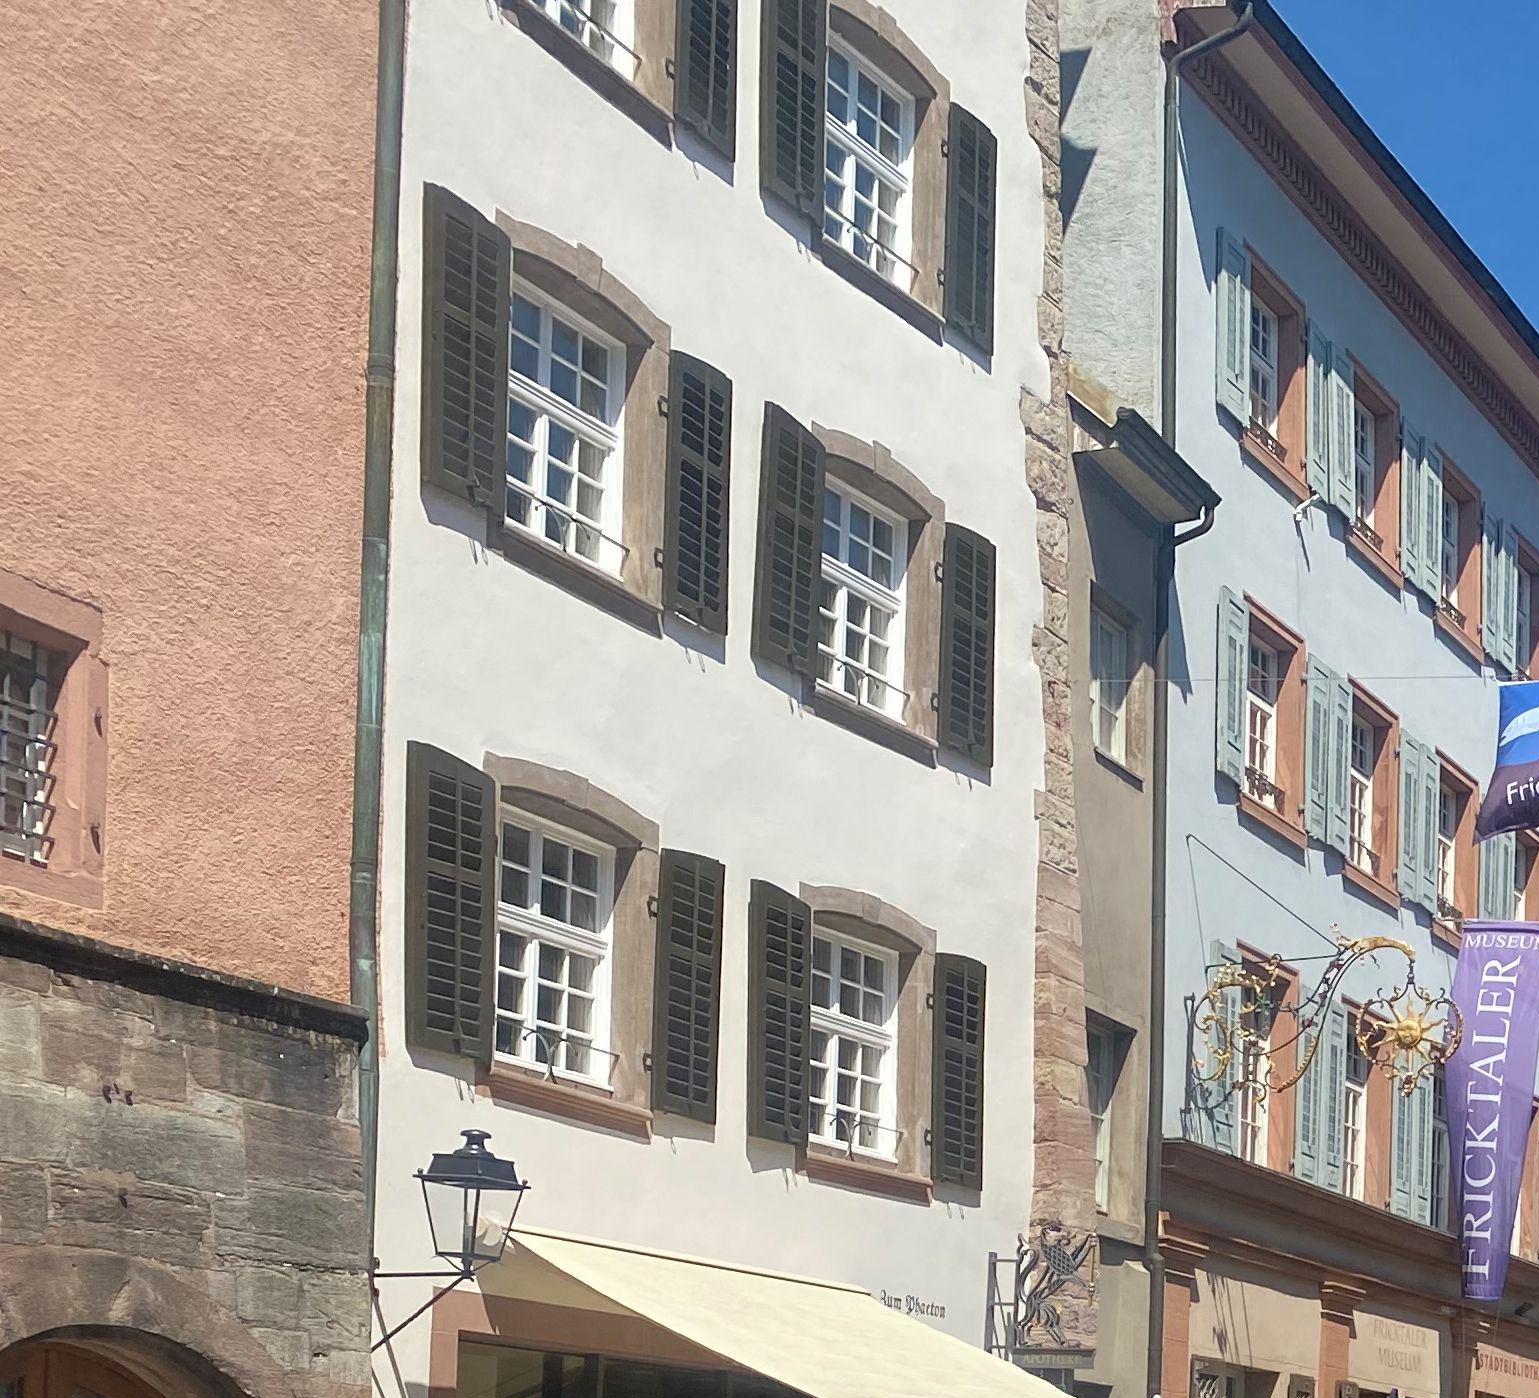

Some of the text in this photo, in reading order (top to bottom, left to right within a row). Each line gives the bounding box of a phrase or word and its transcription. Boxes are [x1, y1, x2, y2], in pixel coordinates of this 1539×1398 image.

[1462, 953, 1523, 1281] FRICKTALER
[1023, 1353, 1082, 1365] APOTHEKE
[1377, 1346, 1422, 1375] MUSEUM
